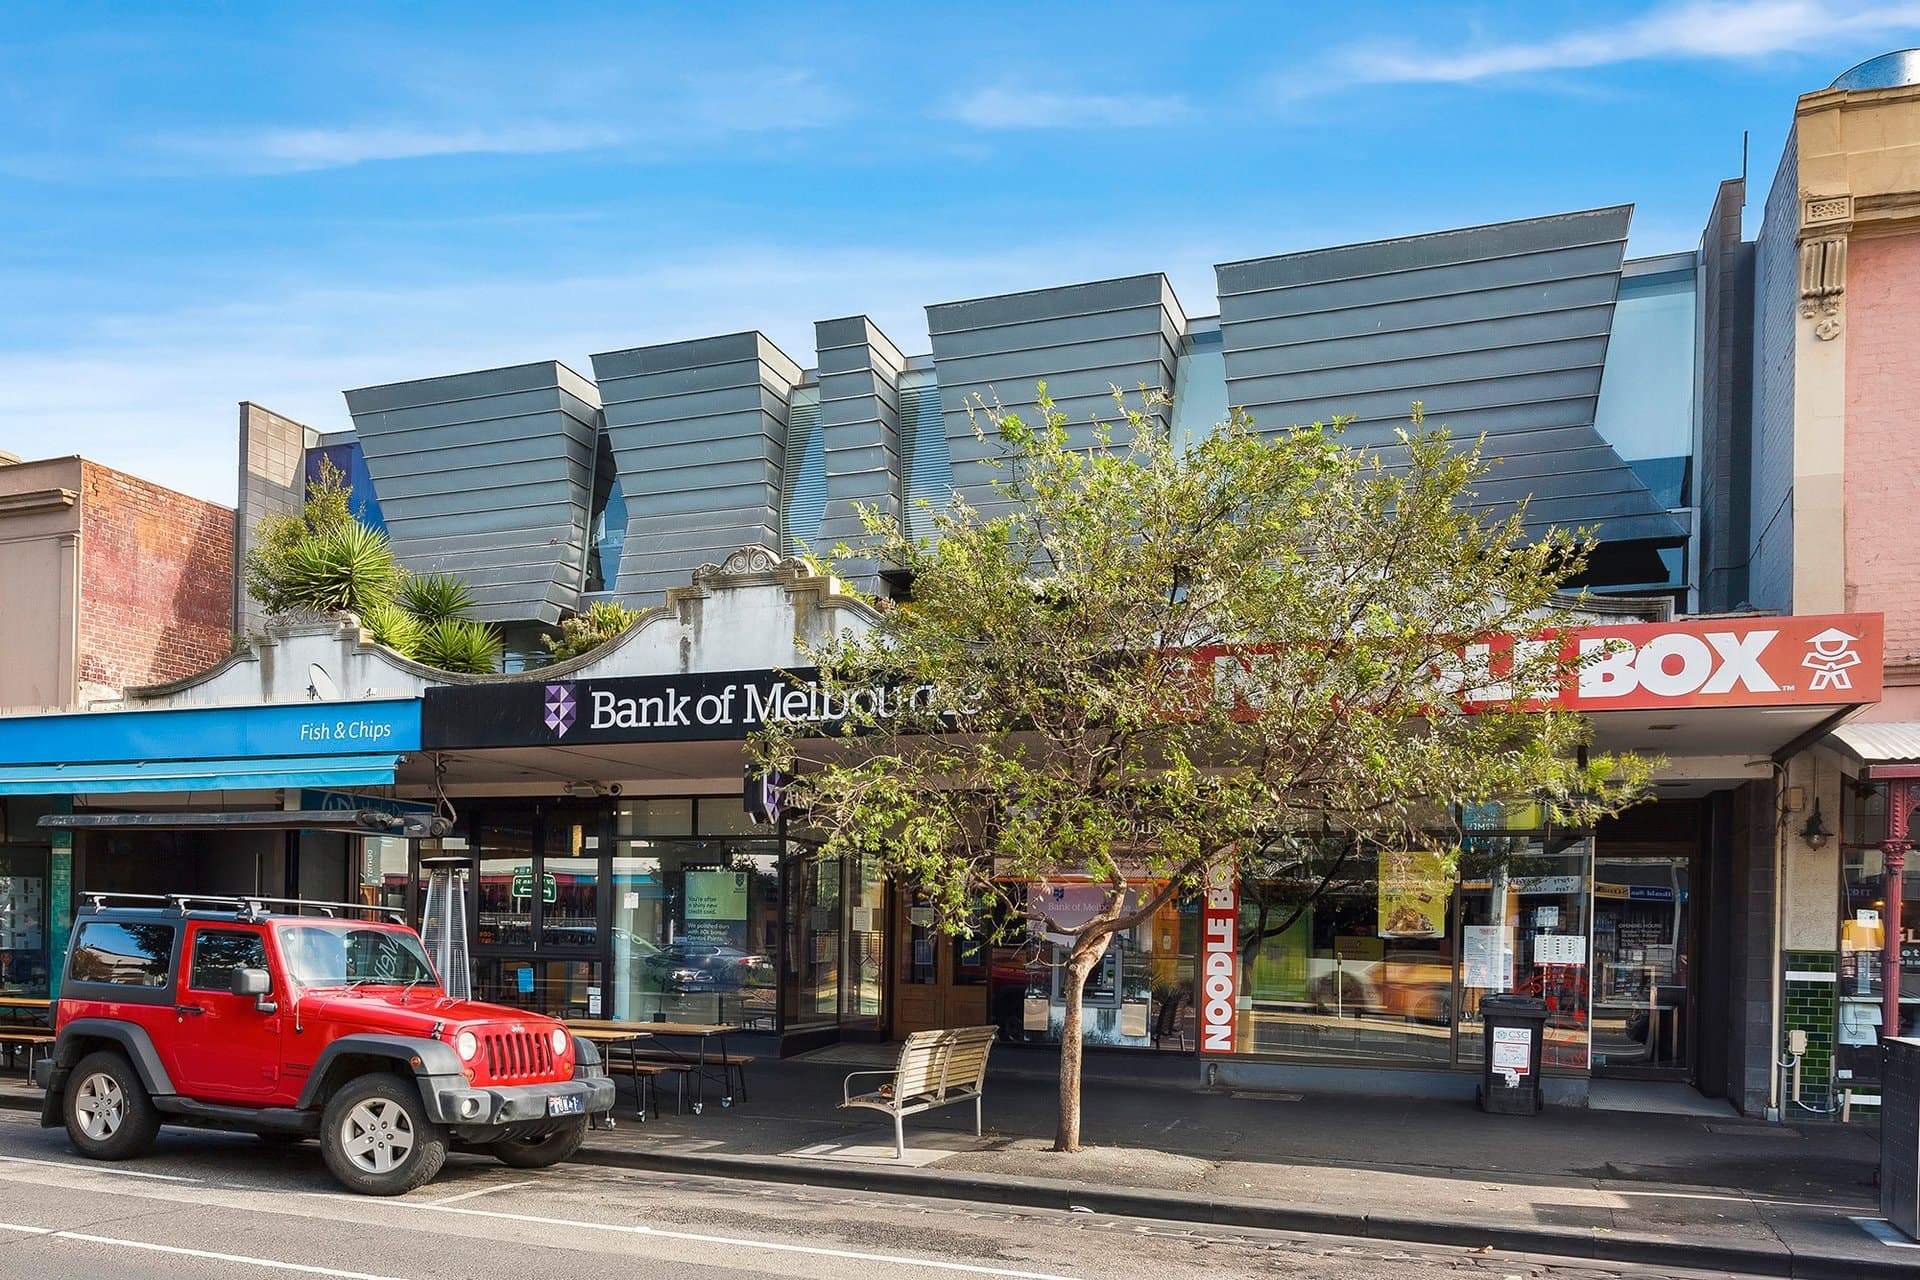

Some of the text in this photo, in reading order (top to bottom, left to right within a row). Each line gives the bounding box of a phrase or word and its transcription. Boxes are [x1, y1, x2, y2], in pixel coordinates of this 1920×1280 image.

[1578, 630, 1781, 697] BOX
[591, 688, 690, 729] Bank
[696, 685, 736, 725] of
[301, 720, 391, 741] Fish & Chips
[1048, 902, 1070, 911] Bank
[1072, 902, 1081, 911] of
[1205, 918, 1234, 1050] NOODLE
